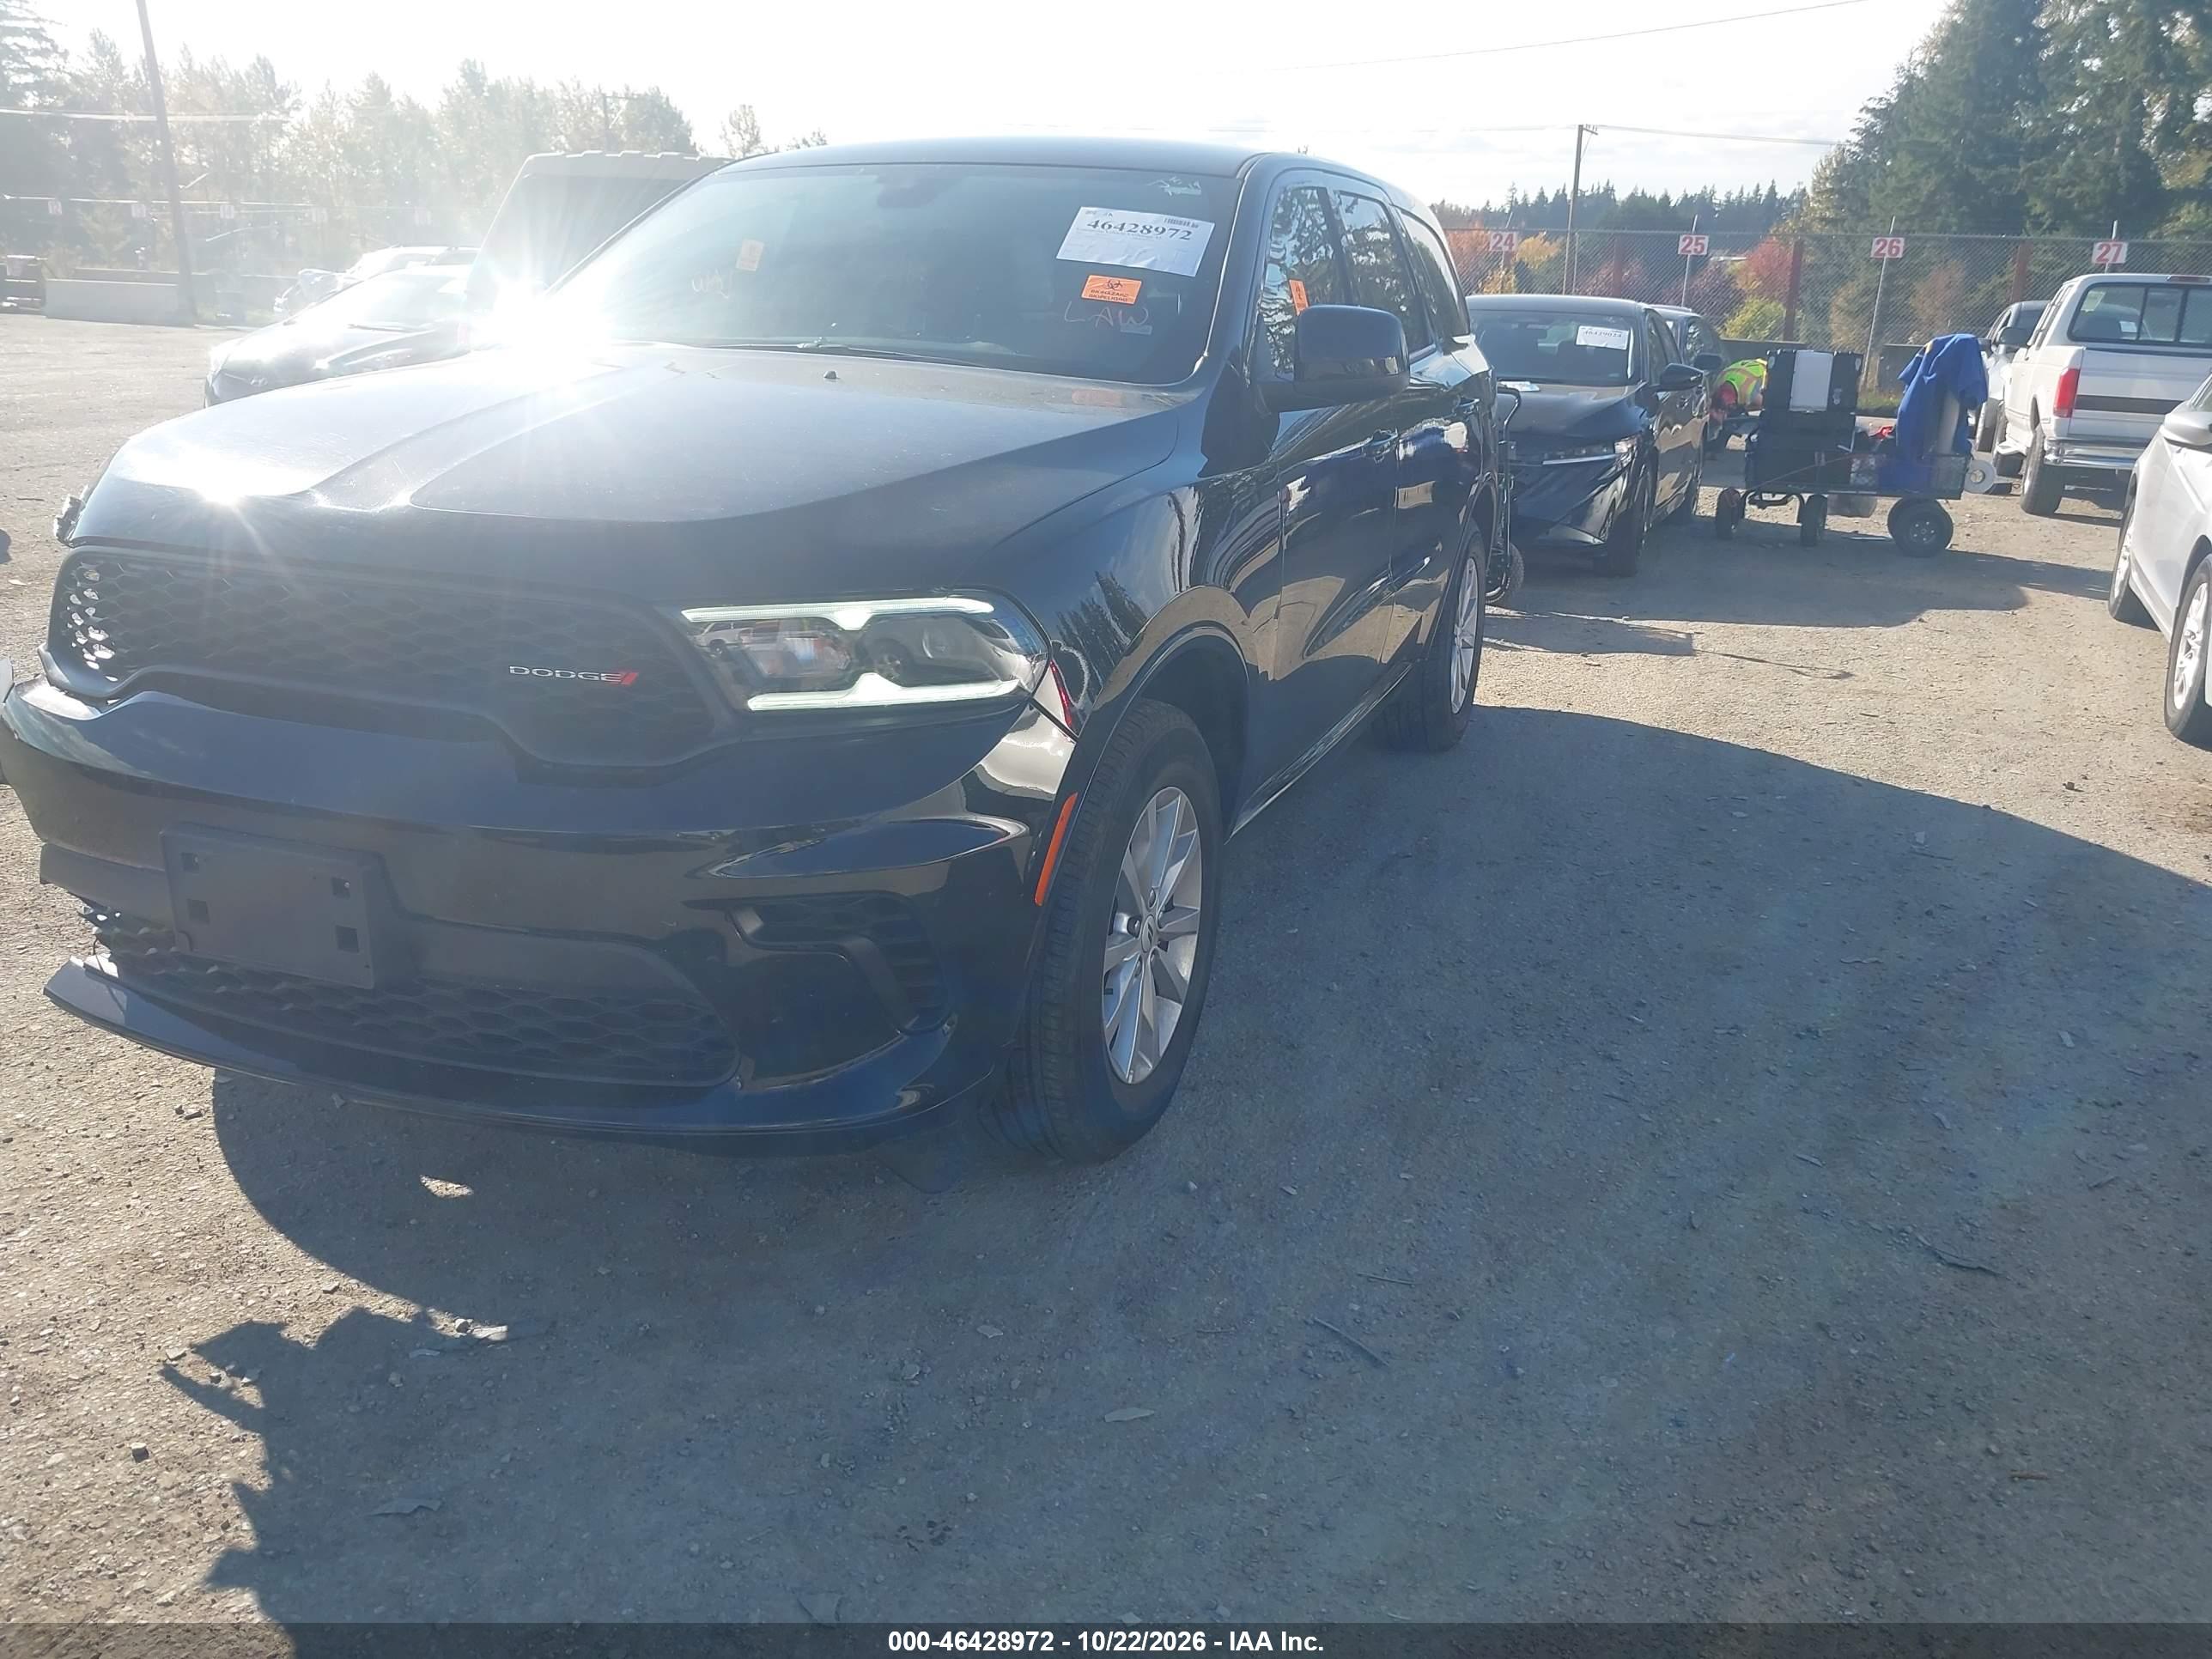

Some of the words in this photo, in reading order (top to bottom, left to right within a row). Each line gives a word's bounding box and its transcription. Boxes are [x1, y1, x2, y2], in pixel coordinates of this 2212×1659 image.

[1087, 219, 1193, 240] 46428972
[1491, 233, 1515, 252] 24
[1680, 236, 1705, 254] 25
[1874, 238, 1901, 257] 26
[2095, 243, 2123, 264] 27
[508, 665, 623, 683] DODGE
